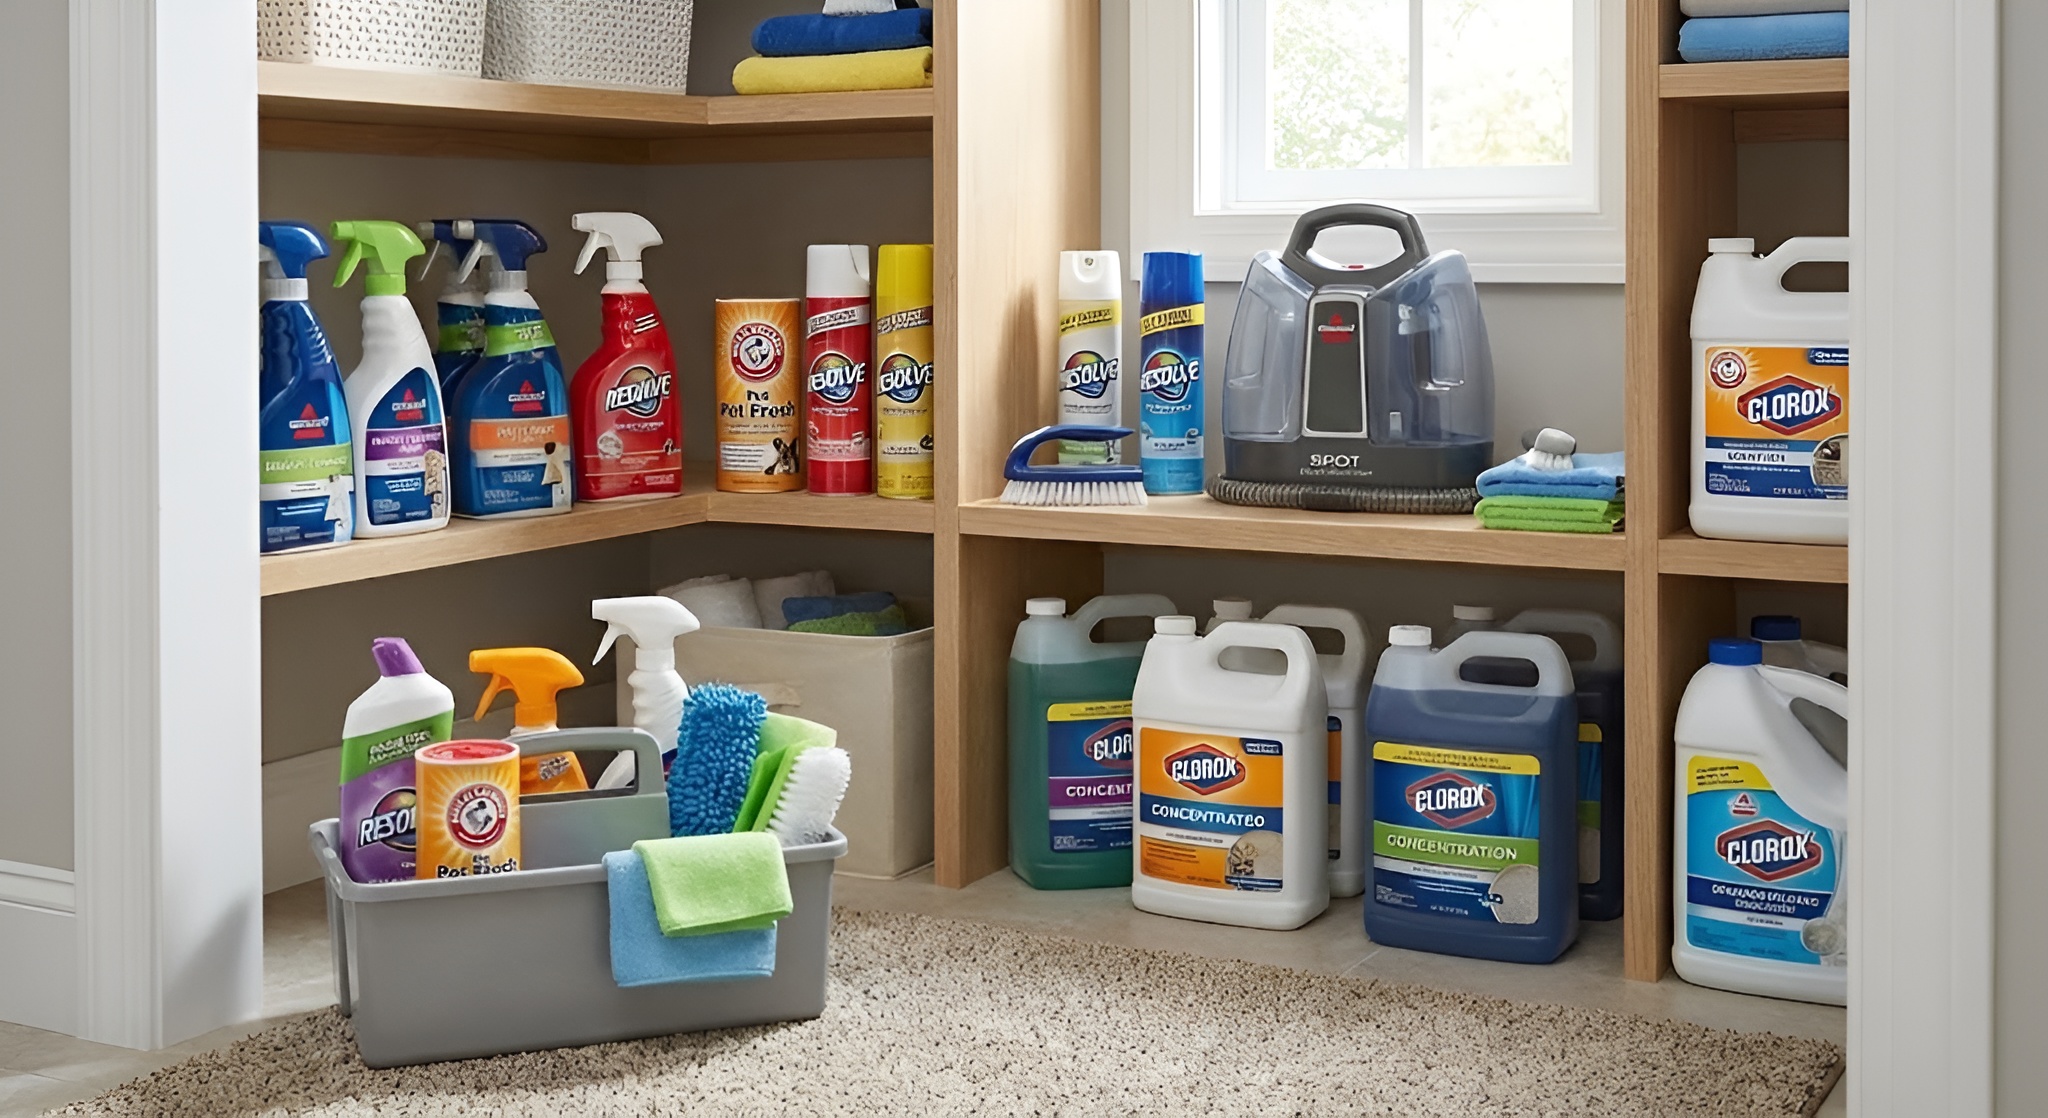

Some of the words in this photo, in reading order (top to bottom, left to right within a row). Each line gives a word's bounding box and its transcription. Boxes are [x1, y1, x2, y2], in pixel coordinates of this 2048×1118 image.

[1747, 387, 1830, 423] CLOROX
[1310, 454, 1360, 467] SPOT
[1172, 756, 1237, 782] CLOROX
[1415, 783, 1486, 813] CLOROX
[1387, 834, 1518, 860] CONCENTRATION
[1726, 834, 1810, 865] CLOROX
